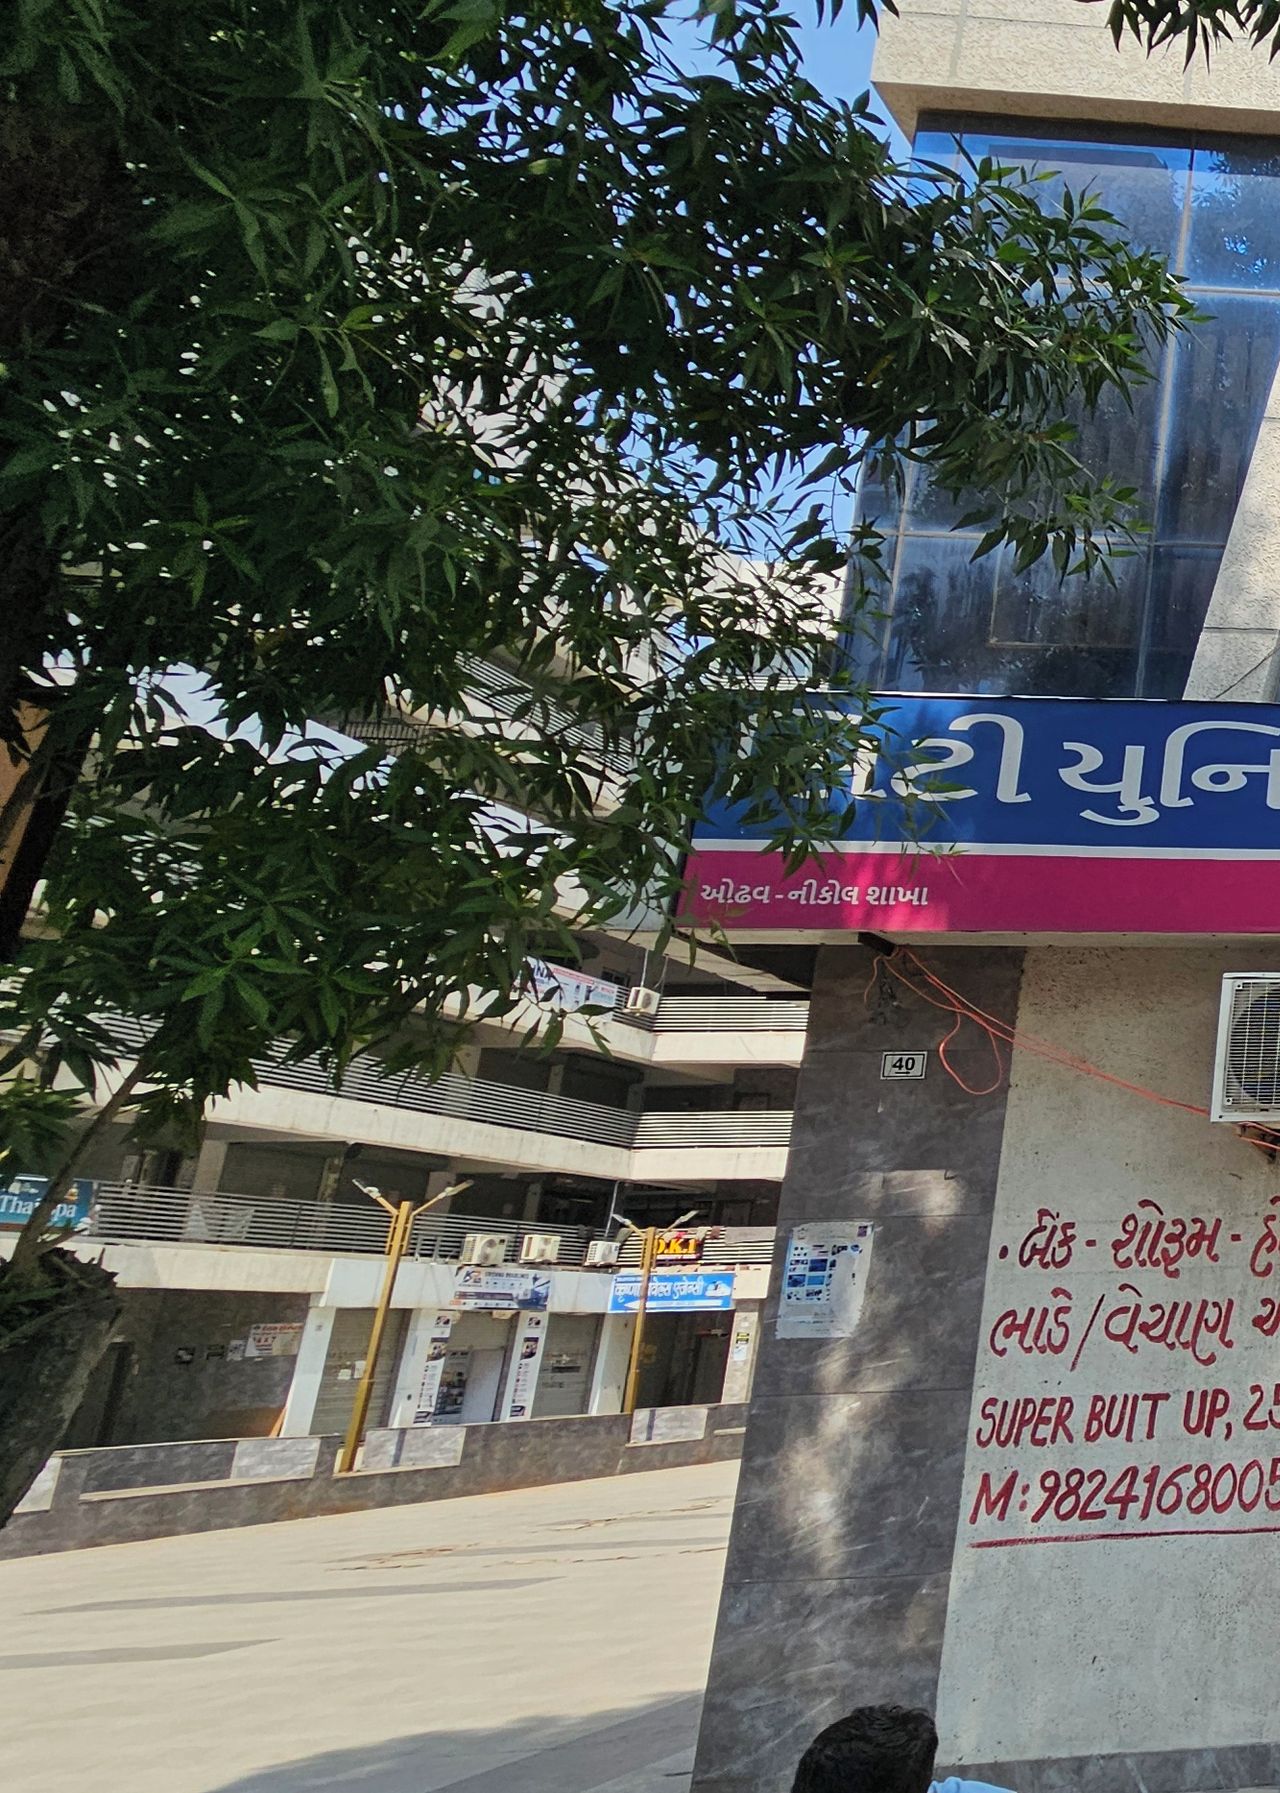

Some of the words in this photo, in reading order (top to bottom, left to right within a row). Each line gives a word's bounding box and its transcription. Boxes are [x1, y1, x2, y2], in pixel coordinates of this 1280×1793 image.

[788, 879, 859, 905] નીકોલ
[865, 886, 929, 906] શાખા
[892, 1056, 916, 1071] 40
[1111, 1198, 1223, 1279] શોરૂમ
[976, 1395, 1075, 1450] SUPER
[1083, 1392, 1171, 1444] BUIT
[1183, 1386, 1234, 1442] UP,
